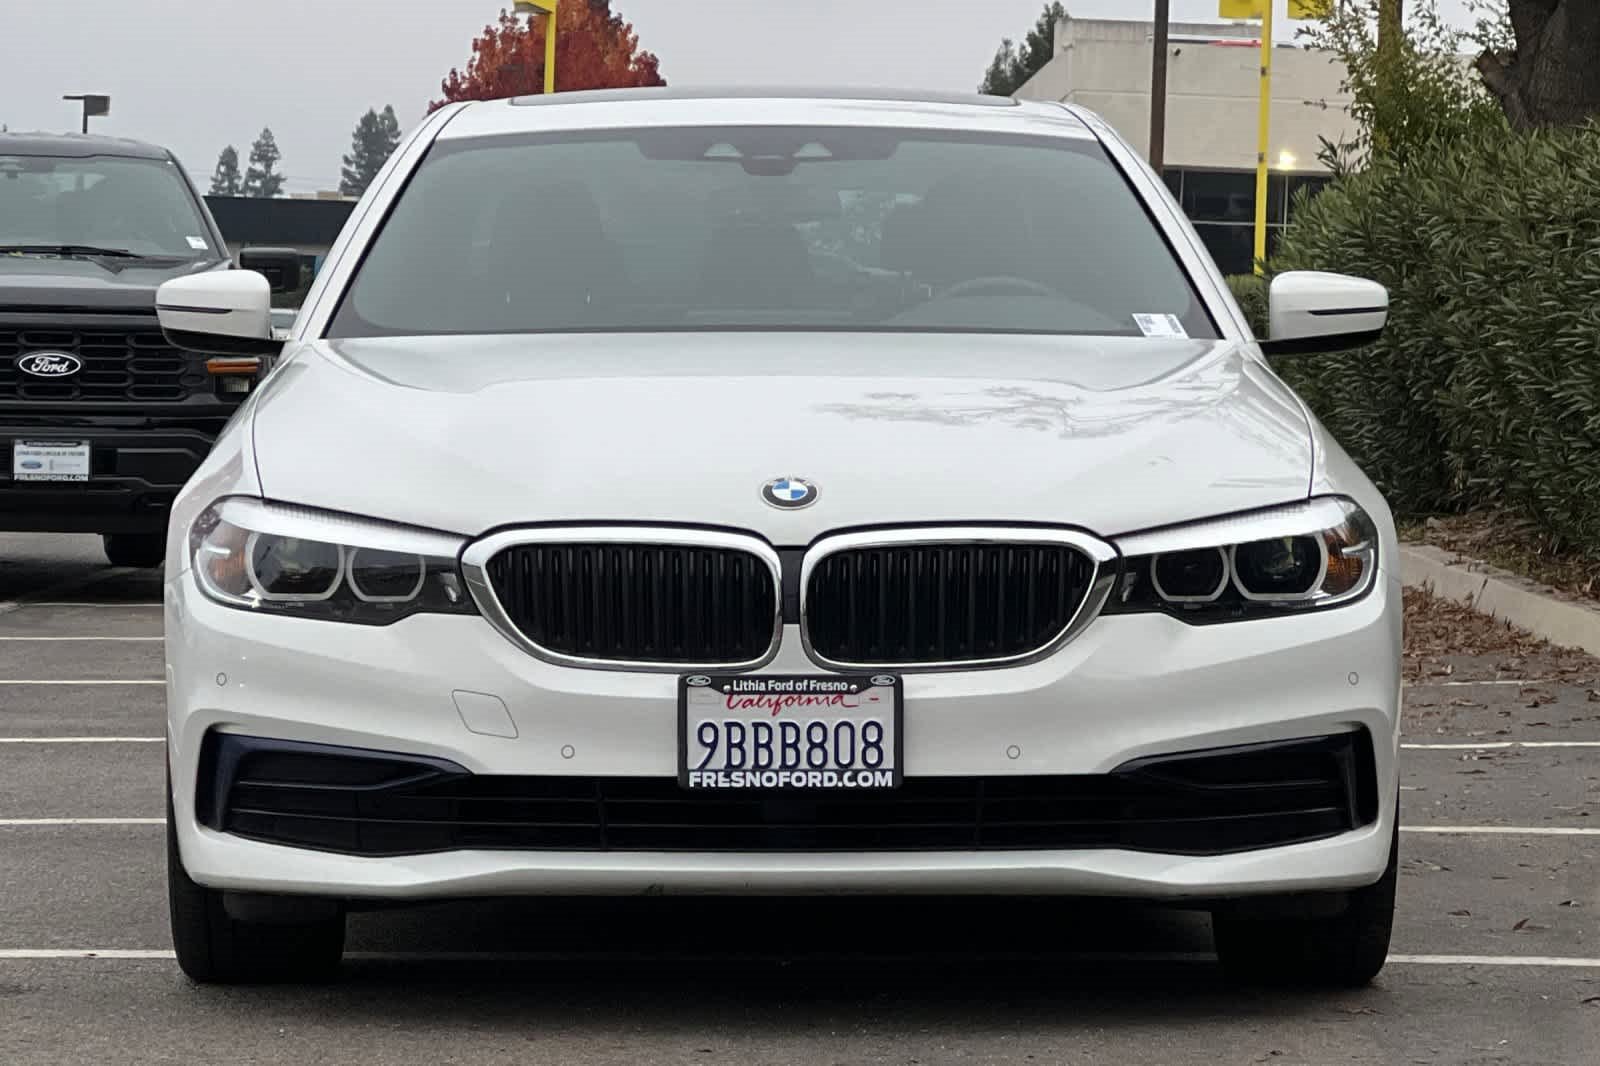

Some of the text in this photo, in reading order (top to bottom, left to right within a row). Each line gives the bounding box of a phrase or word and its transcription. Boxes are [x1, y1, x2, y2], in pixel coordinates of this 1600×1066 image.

[31, 356, 70, 373] Ford
[733, 680, 848, 692] Lithia Ford of Fresno
[726, 693, 859, 717] California
[697, 720, 884, 770] 9BBB808
[689, 771, 893, 788] FRESNOFORD.COM
